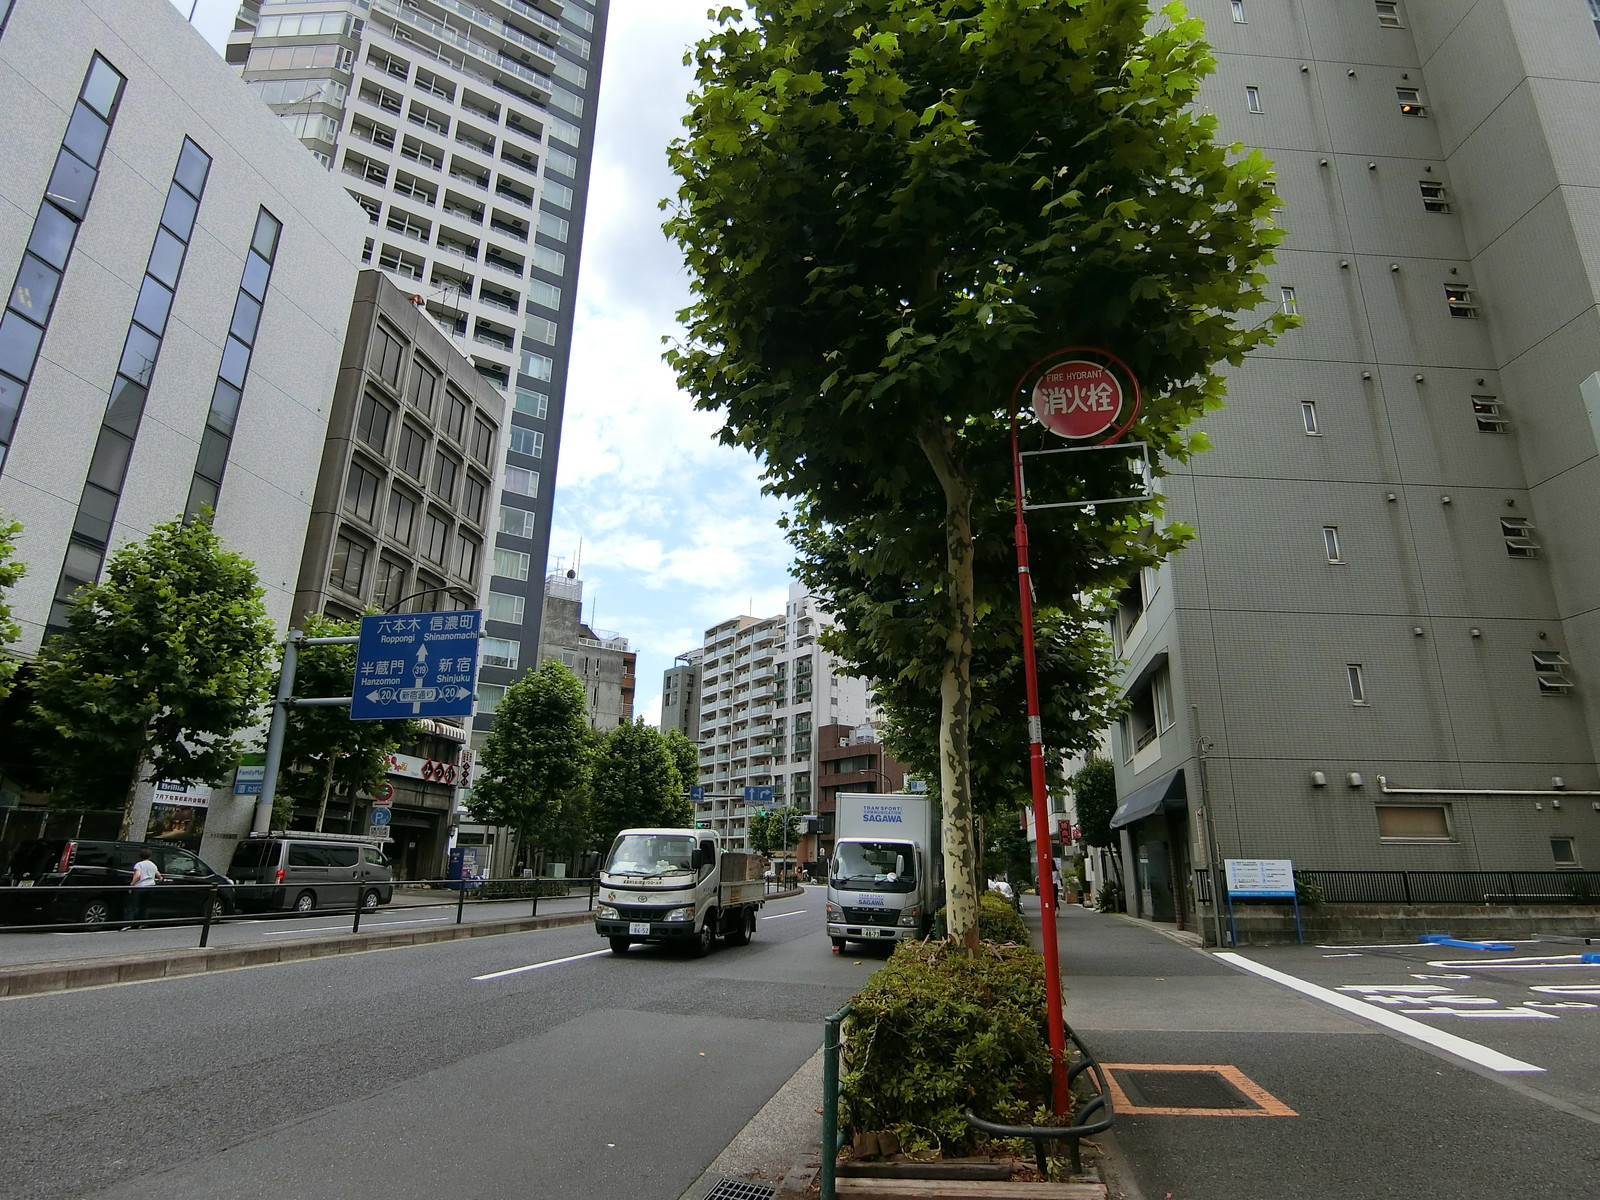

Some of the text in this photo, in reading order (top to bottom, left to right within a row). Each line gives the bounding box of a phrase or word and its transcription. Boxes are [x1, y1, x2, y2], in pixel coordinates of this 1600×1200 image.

[1046, 370, 1103, 382] FIRE HYDRANT
[1042, 382, 1113, 416] 消火栓
[377, 615, 475, 634] 六本木 信濃町
[381, 631, 478, 645] Roppongi Shinanomachi
[360, 660, 405, 676] 半蔵門
[438, 657, 472, 673] 新宿
[414, 666, 427, 675] 319
[361, 677, 401, 686] Hanzomon
[437, 674, 471, 684] Shinjuku
[381, 690, 391, 700] 20
[402, 689, 434, 700] 新宿通り
[445, 687, 455, 697] 20
[161, 782, 185, 792] Brillia
[863, 814, 903, 823] SAGAWA
